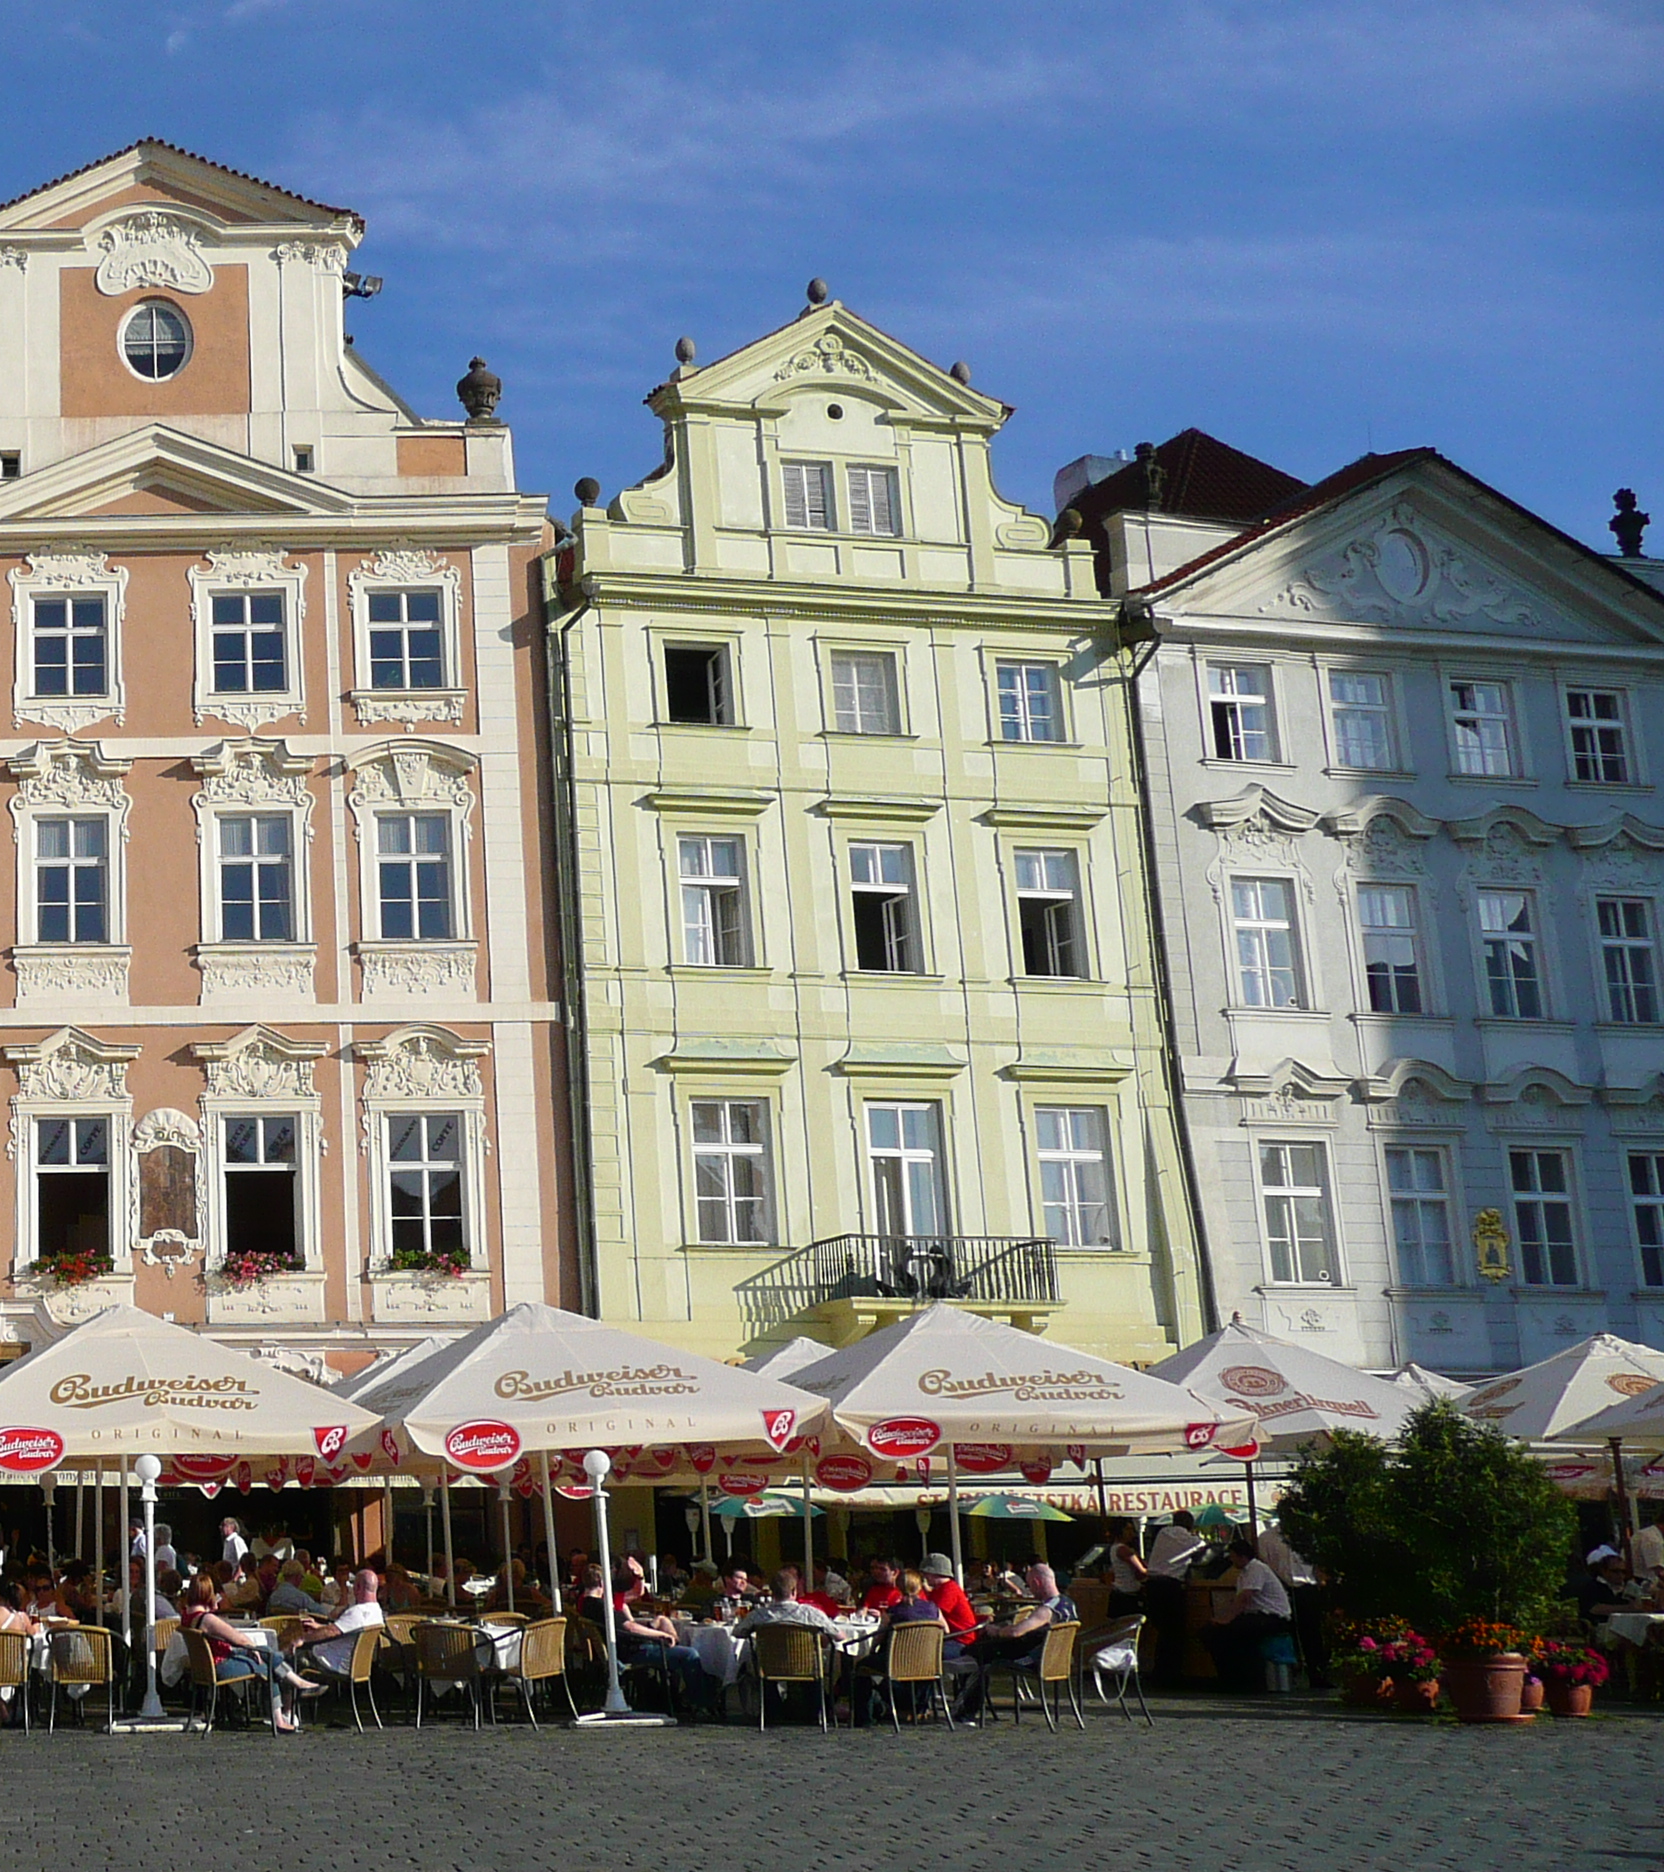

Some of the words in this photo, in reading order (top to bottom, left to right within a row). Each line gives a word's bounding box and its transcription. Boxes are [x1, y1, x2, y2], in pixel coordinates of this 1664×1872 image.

[50, 1374, 260, 1409] Budweiser
[494, 1364, 698, 1402] Budweiser
[589, 1382, 700, 1398] Budvar
[918, 1370, 1120, 1399] Budweiser
[143, 1391, 258, 1410] Budvar
[1014, 1387, 1125, 1400] Budvar
[91, 1428, 244, 1440] ORIGINAL
[546, 1417, 696, 1434] ORIGINAL
[449, 1431, 515, 1455] Budweiser
[477, 1445, 512, 1456] Budvar
[18, 1448, 55, 1459] Budvar
